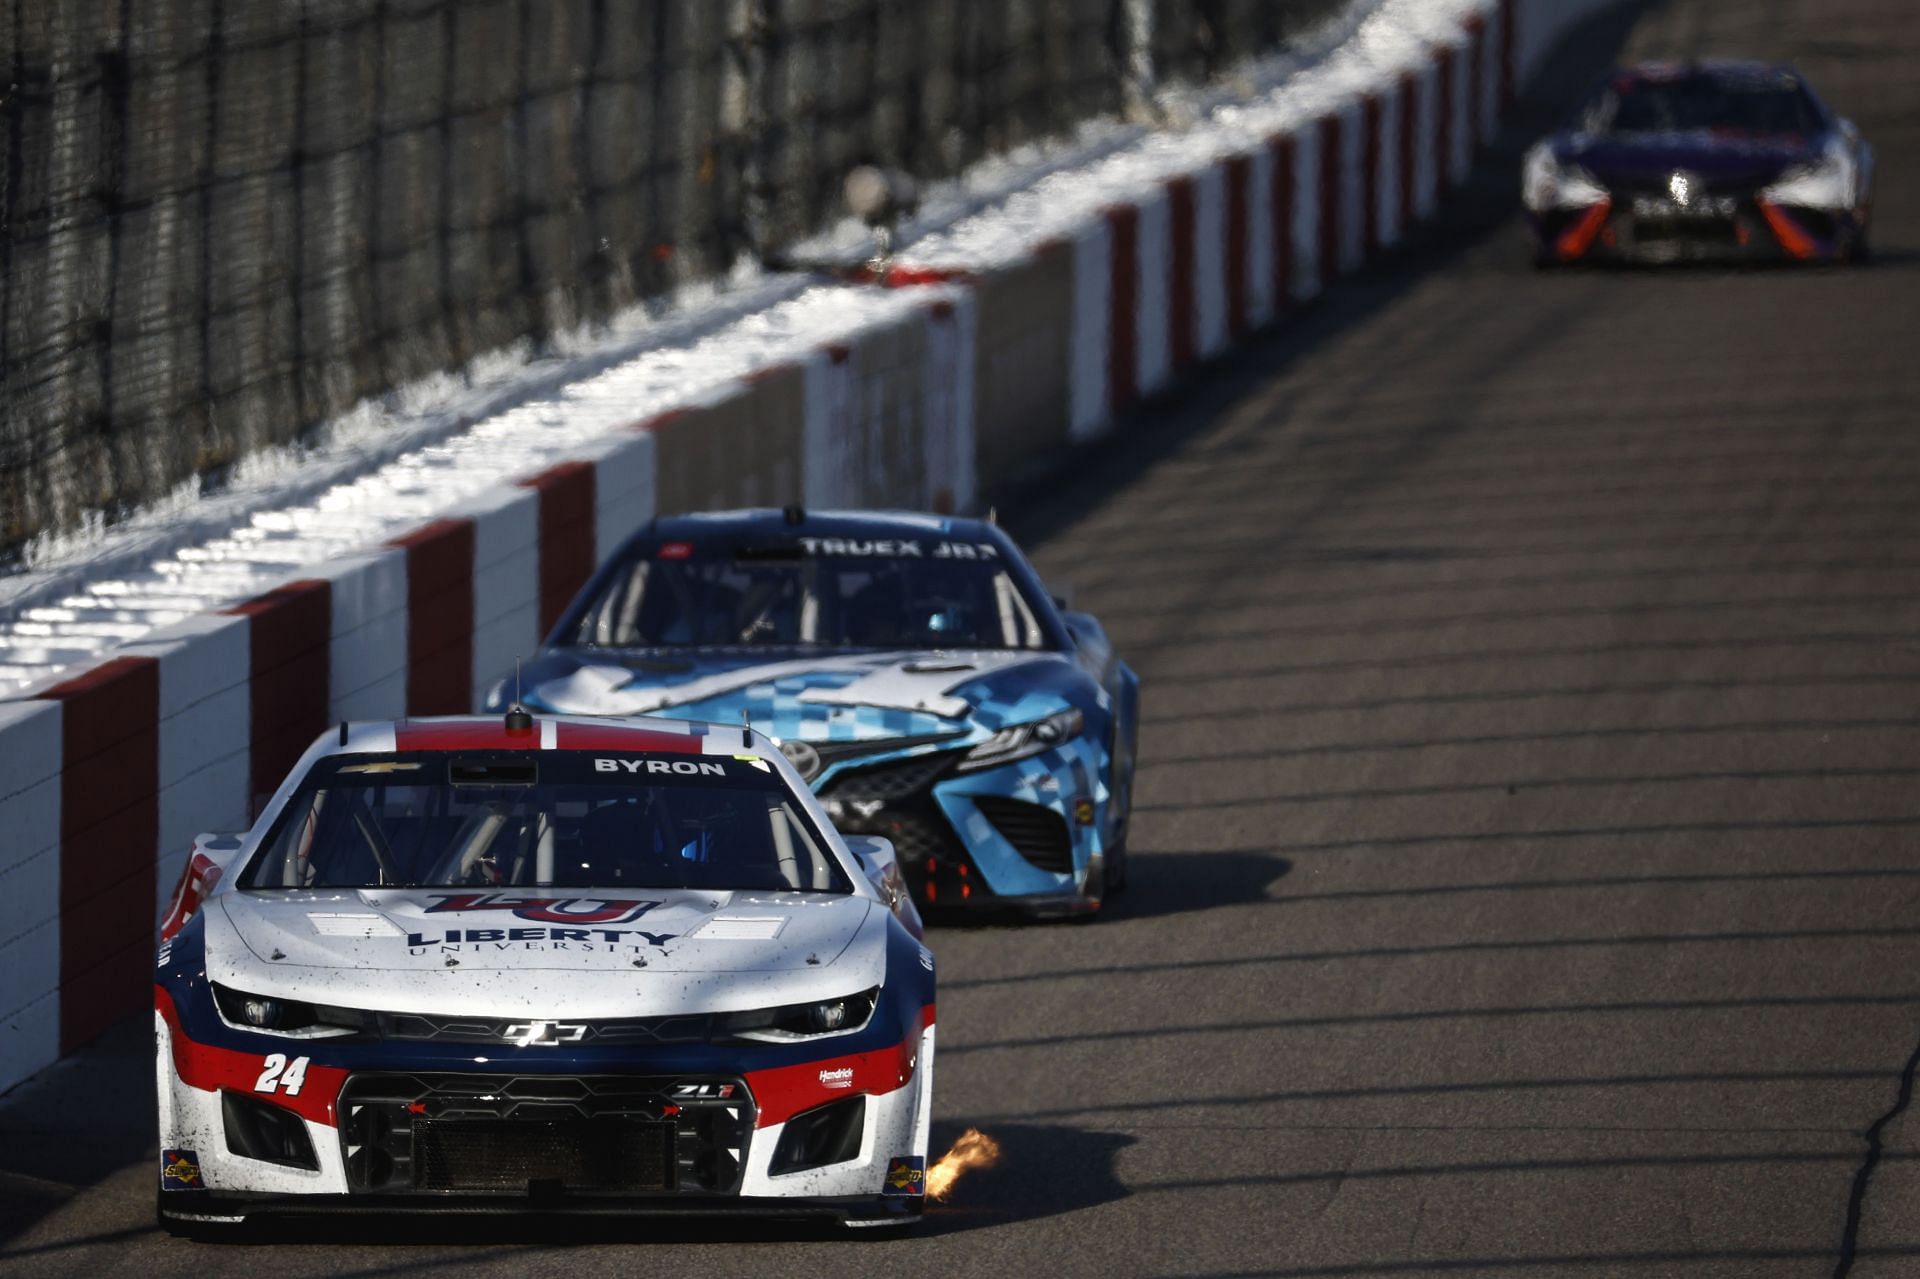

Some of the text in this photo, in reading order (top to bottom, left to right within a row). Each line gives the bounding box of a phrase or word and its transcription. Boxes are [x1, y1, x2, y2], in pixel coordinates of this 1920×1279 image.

[800, 537, 922, 557] TRUEX
[595, 758, 726, 776] BYRON
[407, 927, 681, 947] LIBERTY
[409, 941, 676, 957] UNIVERSITY
[254, 1052, 310, 1096] 24
[819, 1067, 853, 1083] Hendrick
[671, 1084, 735, 1098] ZL1
